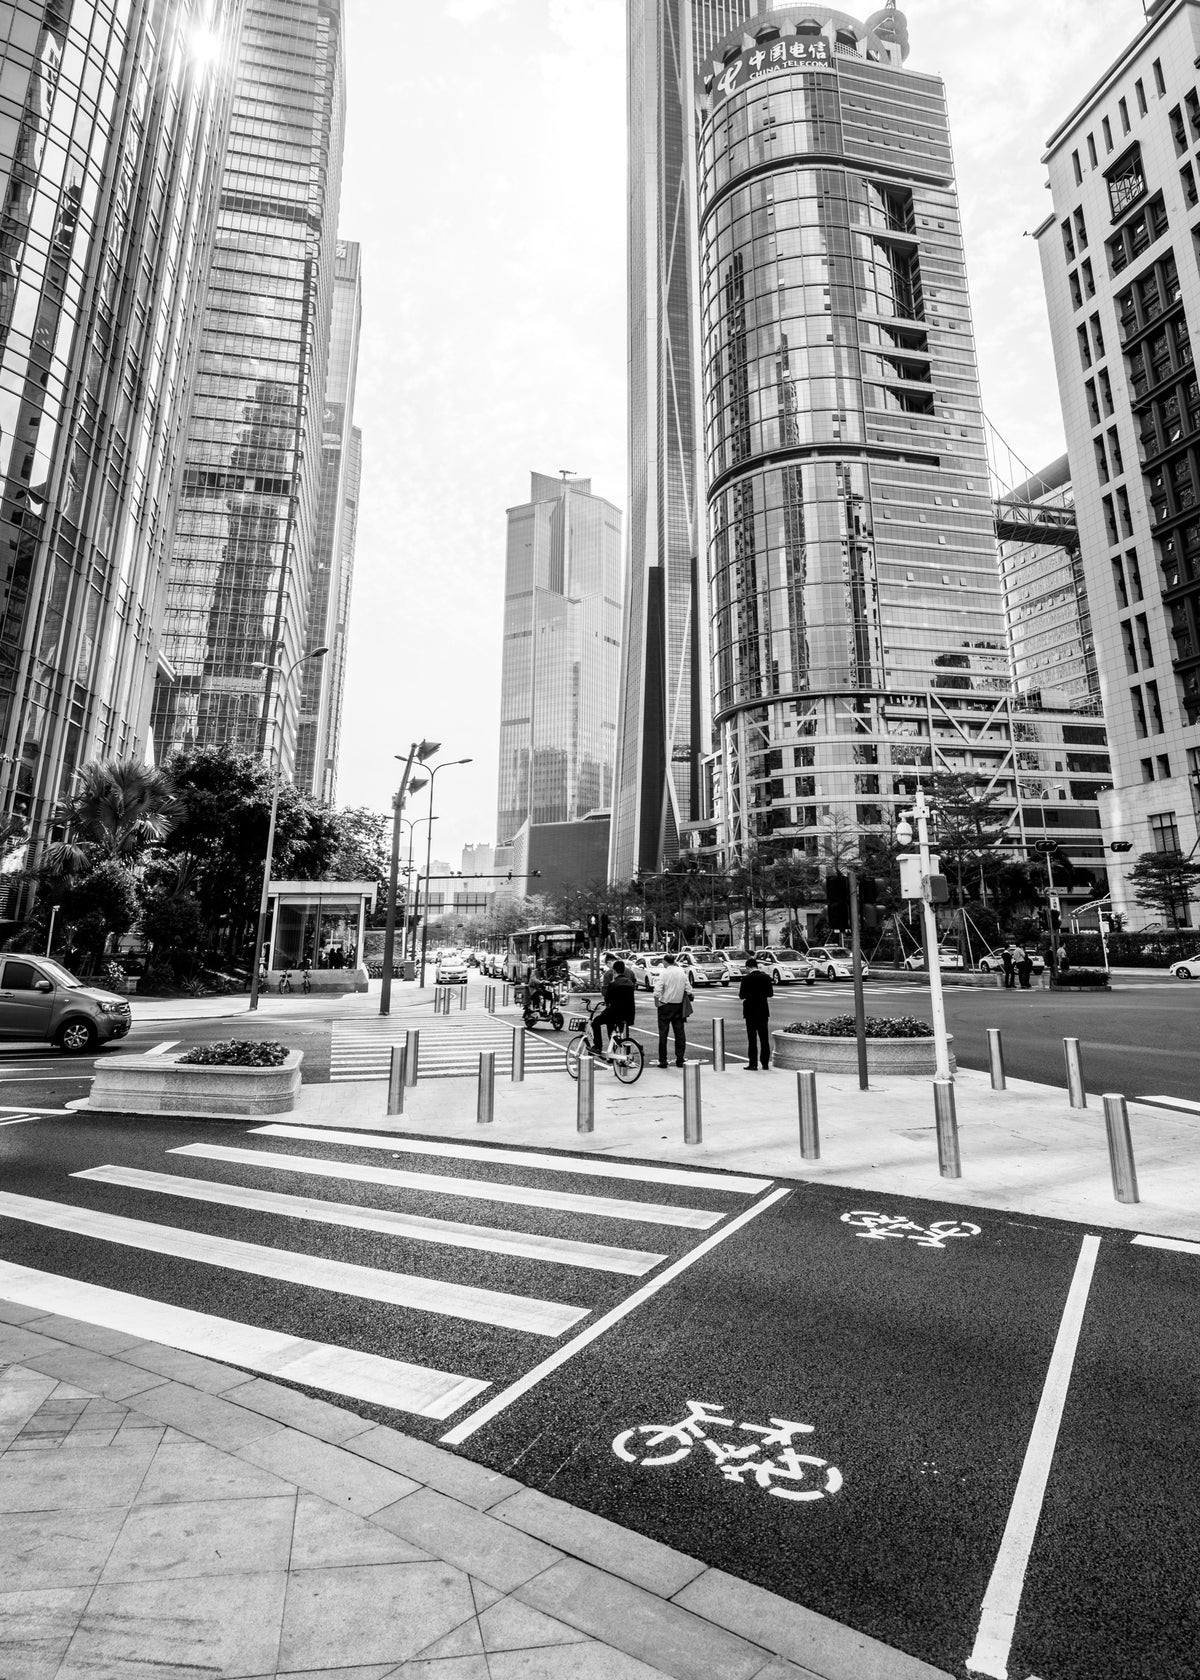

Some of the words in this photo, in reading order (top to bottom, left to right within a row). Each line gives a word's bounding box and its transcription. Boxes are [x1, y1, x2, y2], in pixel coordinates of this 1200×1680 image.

[748, 41, 827, 71] 中国电信
[749, 64, 781, 80] CHINA
[782, 60, 828, 68] TELECOM
